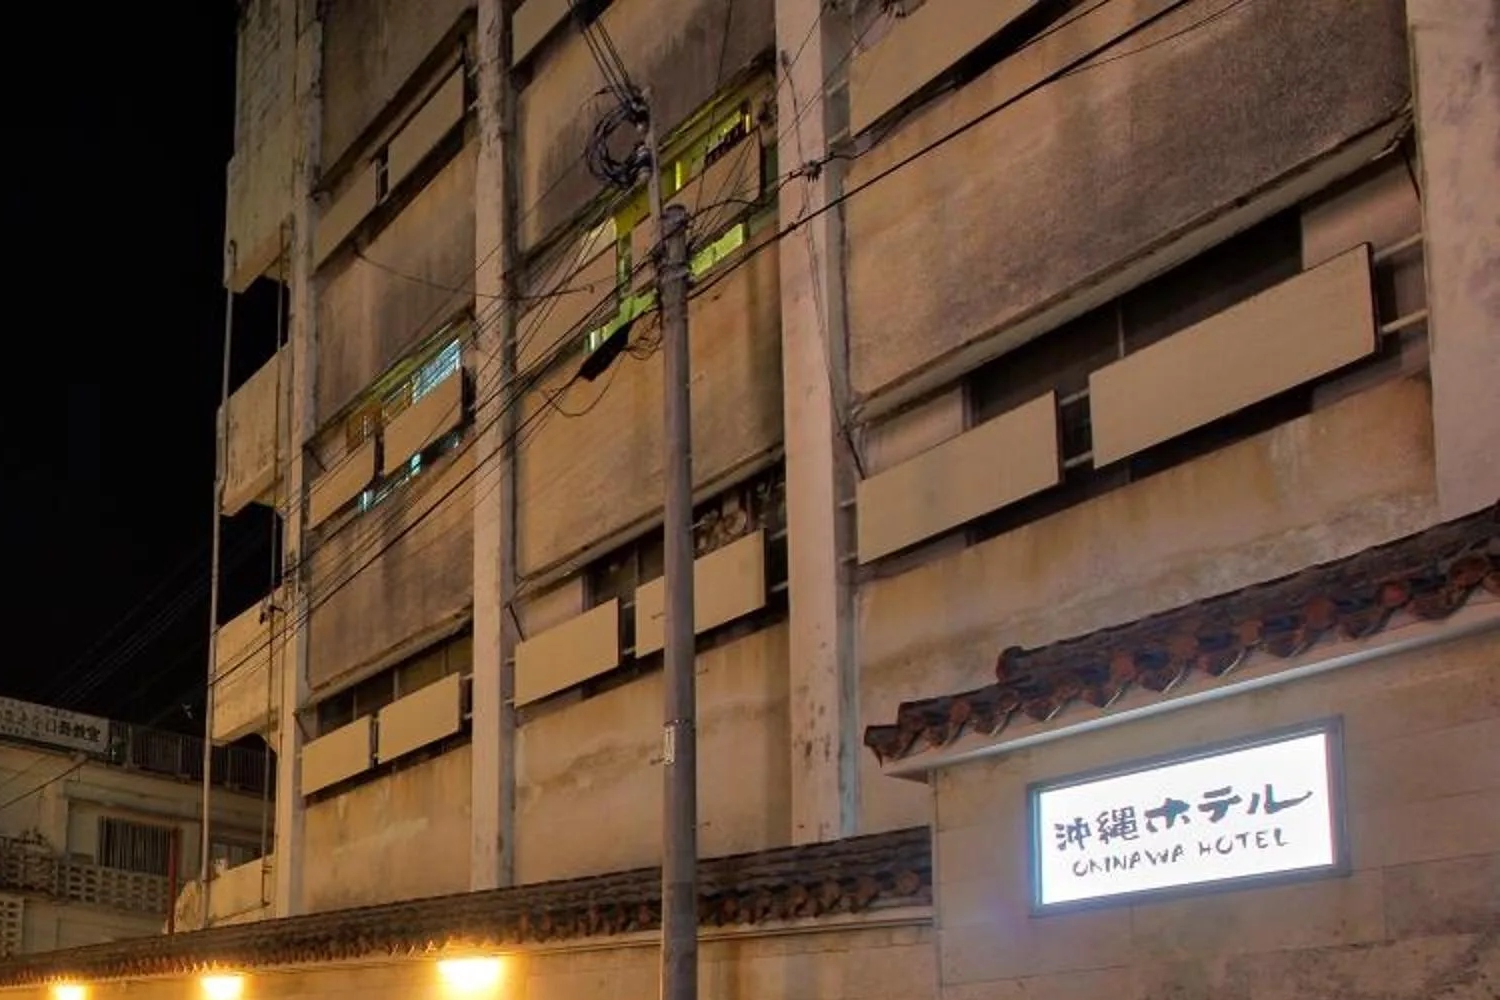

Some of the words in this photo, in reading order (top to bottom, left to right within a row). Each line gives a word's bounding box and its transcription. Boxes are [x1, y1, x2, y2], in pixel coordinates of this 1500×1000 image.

[1054, 783, 1314, 852] 沖縄ホテル
[1072, 844, 1186, 878] OKINAWA
[1198, 827, 1289, 857] HOTEL
